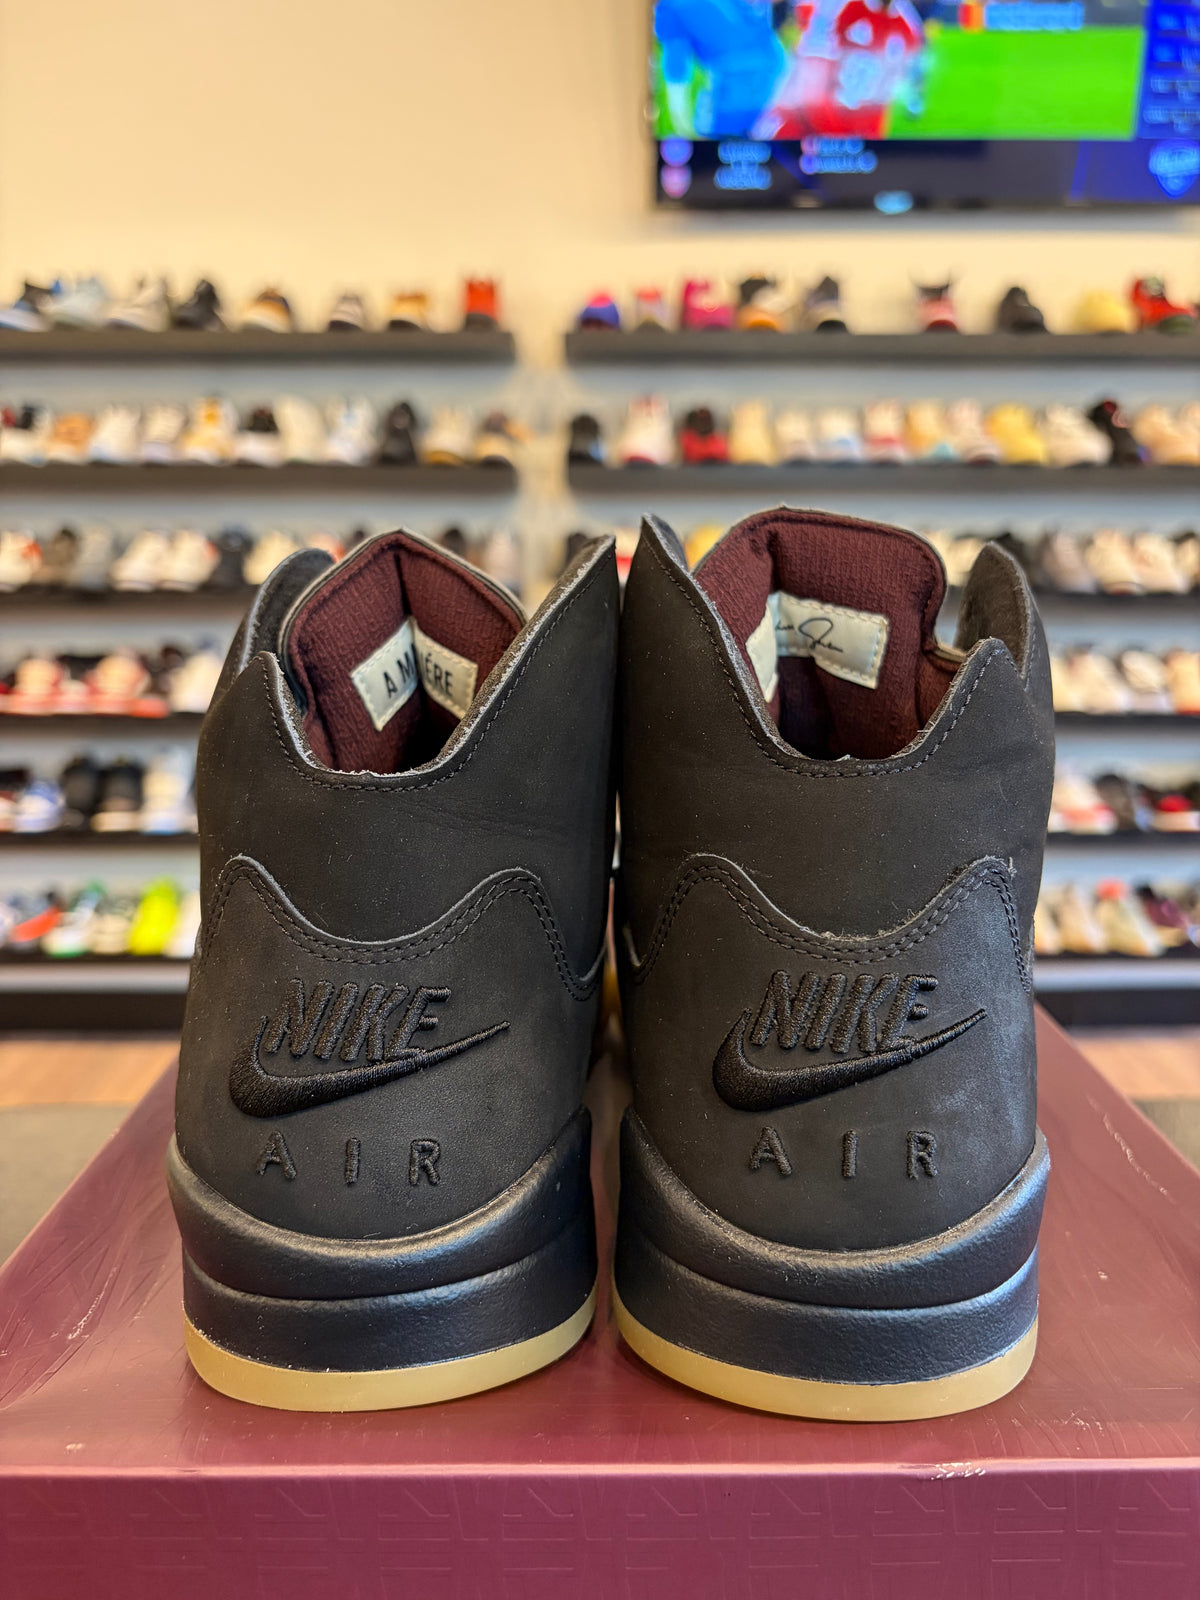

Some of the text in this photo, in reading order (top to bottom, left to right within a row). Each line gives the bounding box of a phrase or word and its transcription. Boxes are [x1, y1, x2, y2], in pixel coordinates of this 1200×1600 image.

[383, 671, 398, 698] A
[264, 978, 451, 1062] NIKE
[752, 970, 939, 1053] NIKE
[256, 1131, 440, 1185] AIR
[750, 1126, 938, 1179] AIR
